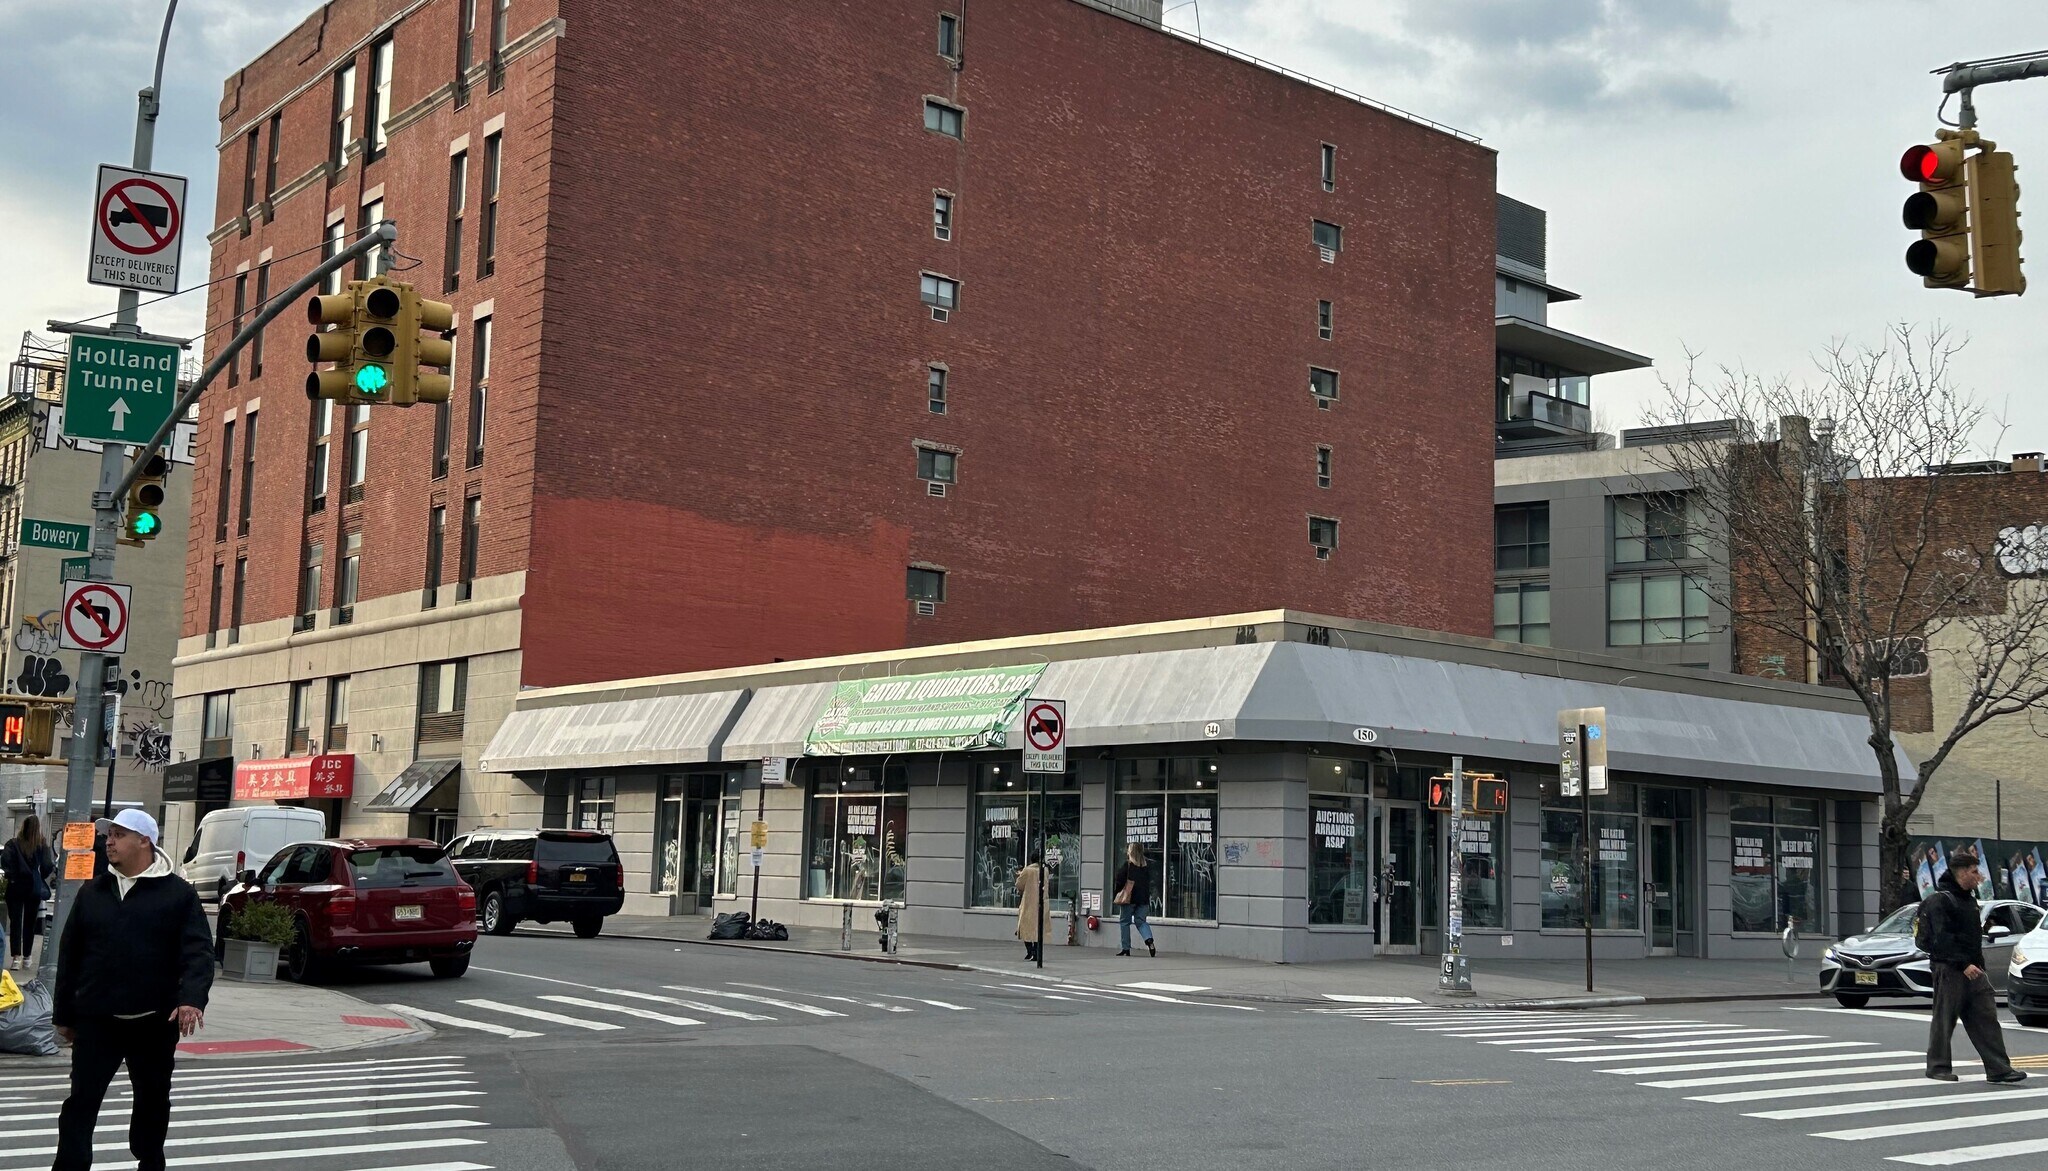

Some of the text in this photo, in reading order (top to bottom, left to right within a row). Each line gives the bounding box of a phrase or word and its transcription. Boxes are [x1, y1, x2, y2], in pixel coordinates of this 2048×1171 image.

[95, 254, 175, 275] EXCEPT DELIVERIES
[104, 269, 162, 286] THIS BLOCK
[76, 346, 172, 372] Holland
[81, 370, 163, 394] Tunnel
[32, 522, 80, 549] Bowery
[862, 680, 912, 703] GATOR
[4, 716, 24, 745] 14
[1207, 726, 1218, 735] 344
[1357, 729, 1374, 741] 150
[1316, 810, 1354, 824] AUCTIONS
[992, 825, 1012, 838] CENTER
[1315, 823, 1355, 837] ARRANGED
[1325, 836, 1345, 848] ASAP
